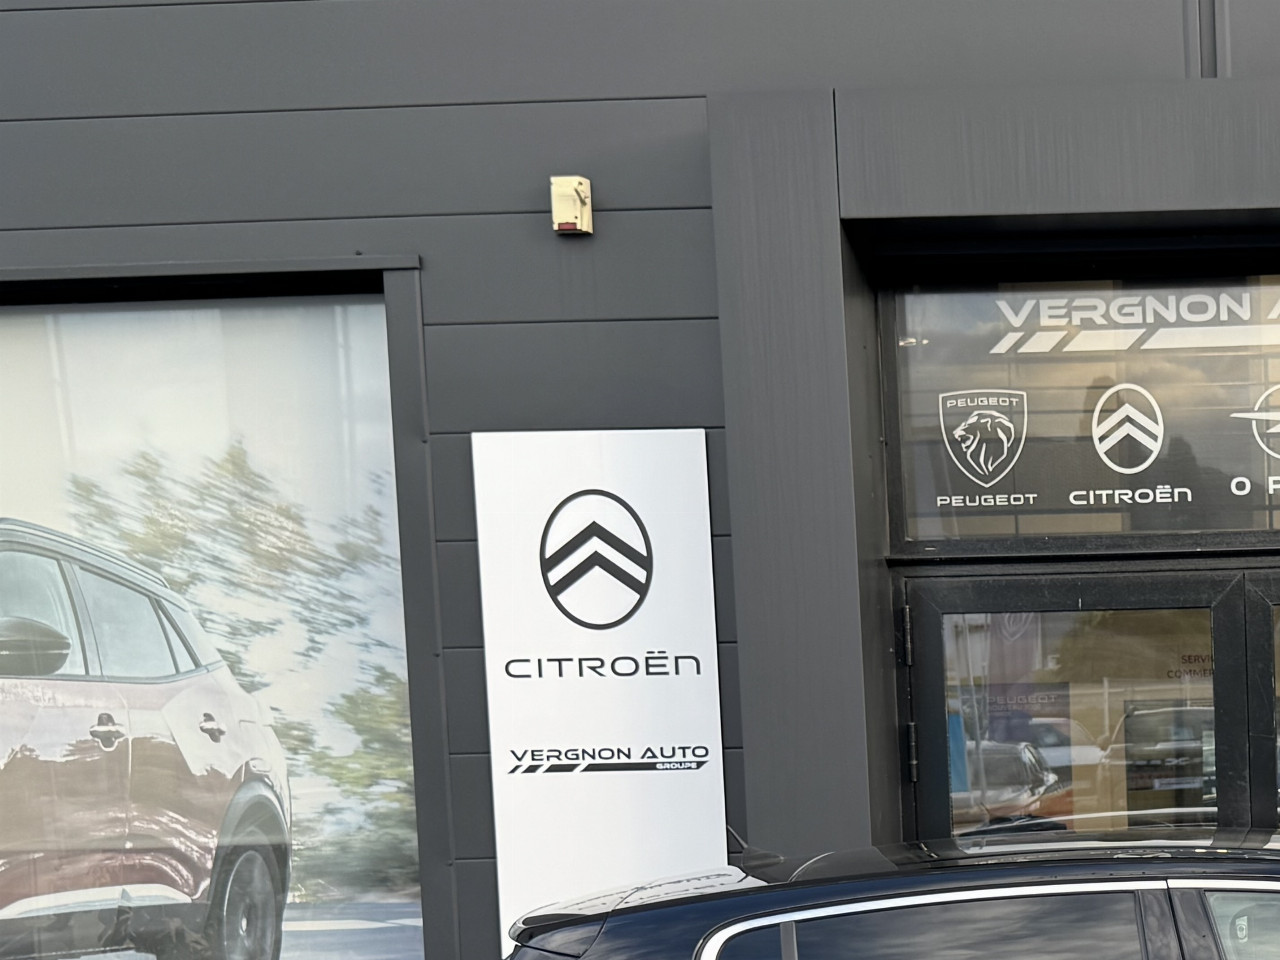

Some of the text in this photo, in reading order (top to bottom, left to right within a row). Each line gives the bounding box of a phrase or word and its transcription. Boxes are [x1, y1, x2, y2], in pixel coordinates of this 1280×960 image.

[994, 292, 1252, 328] VERGNON
[946, 396, 1020, 410] PEUGEOT
[936, 493, 1038, 507] PEUGEOT
[1069, 485, 1193, 506] CITROËN
[505, 650, 702, 678] CITROËN
[1180, 654, 1212, 664] SERVI
[510, 745, 710, 761] VERGNON AUTO
